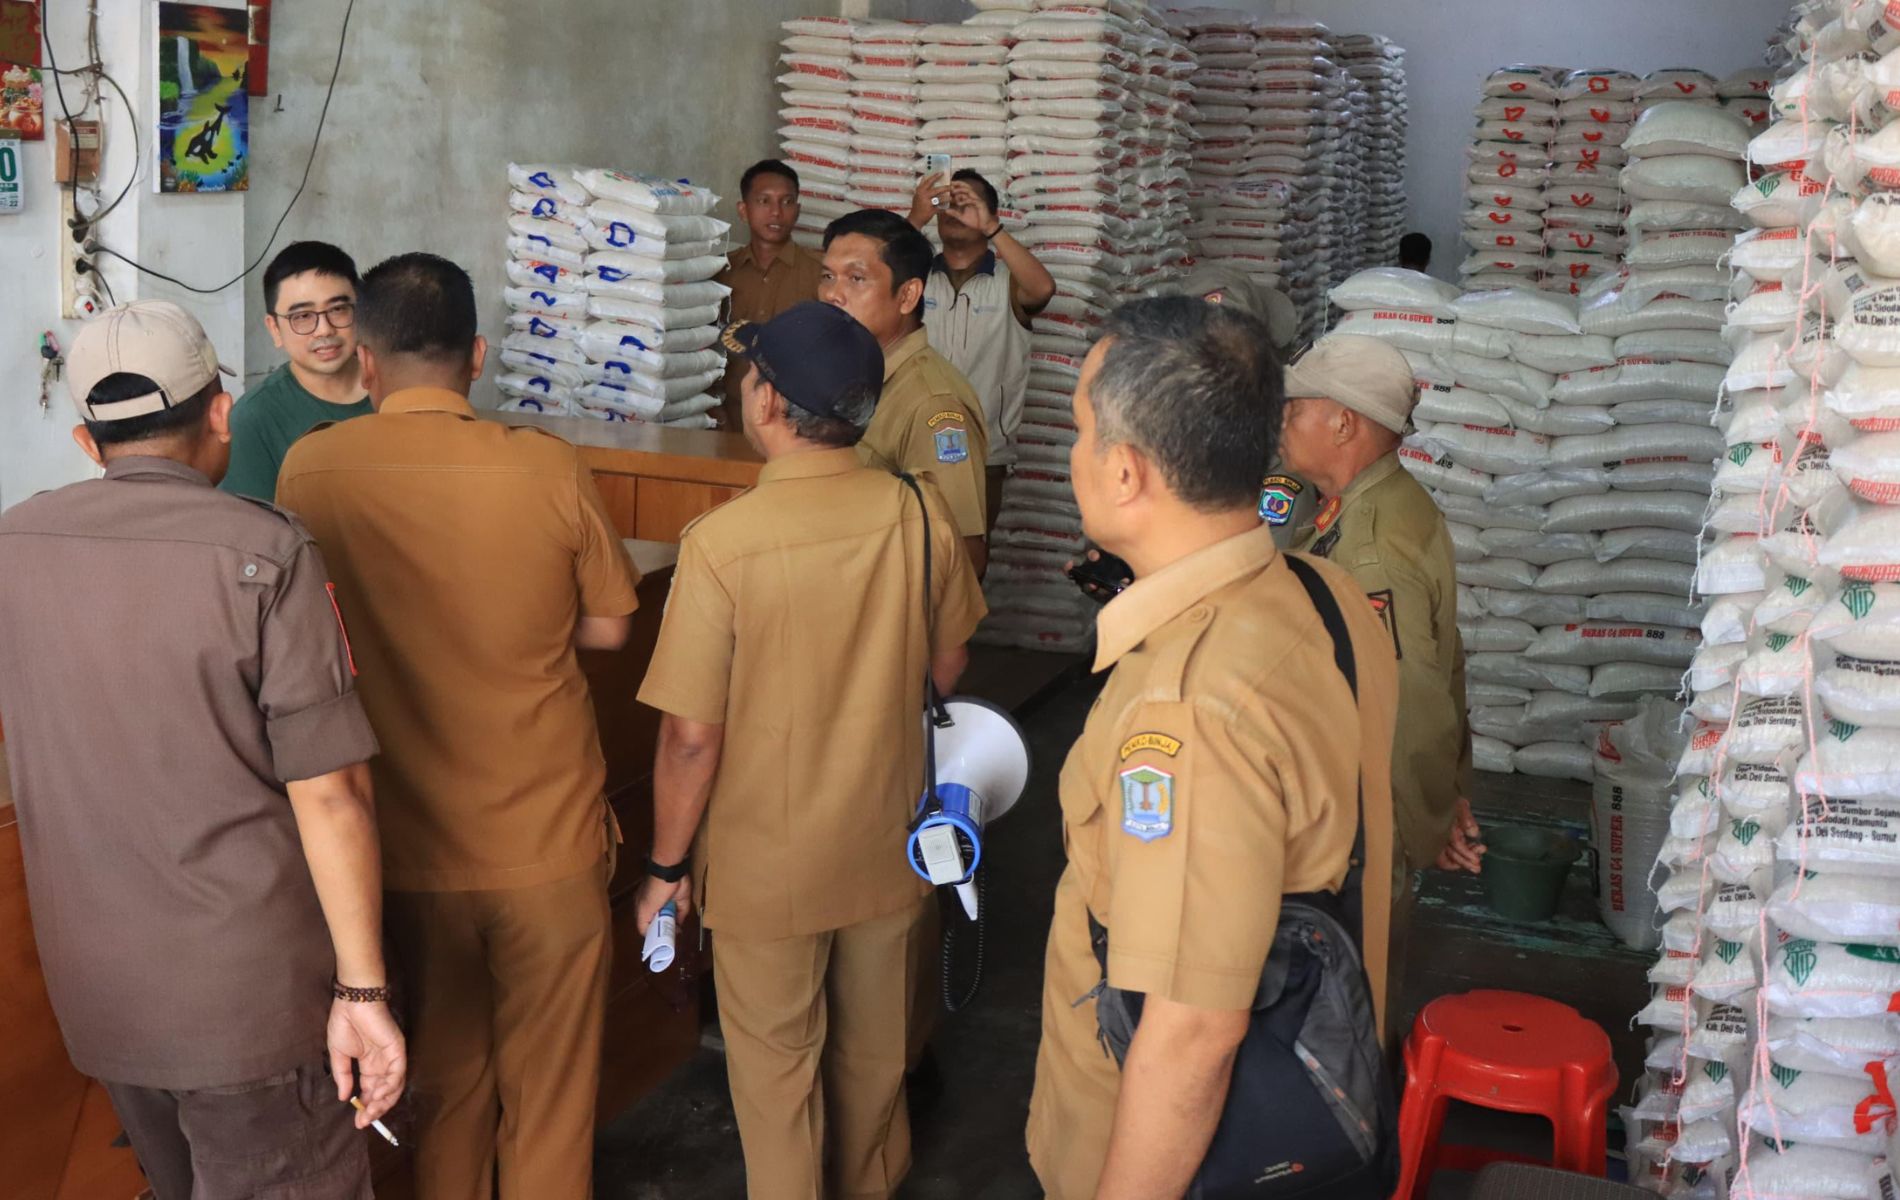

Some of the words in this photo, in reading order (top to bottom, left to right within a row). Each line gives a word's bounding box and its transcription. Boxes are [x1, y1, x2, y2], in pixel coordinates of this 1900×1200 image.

[1645, 629, 1665, 640] 888
[1611, 785, 1623, 810] 888
[1852, 816, 1888, 828] Ramunia
[1610, 814, 1623, 854] SUPER
[1871, 830, 1898, 843] Sumut
[1610, 873, 1624, 912] BERAS
